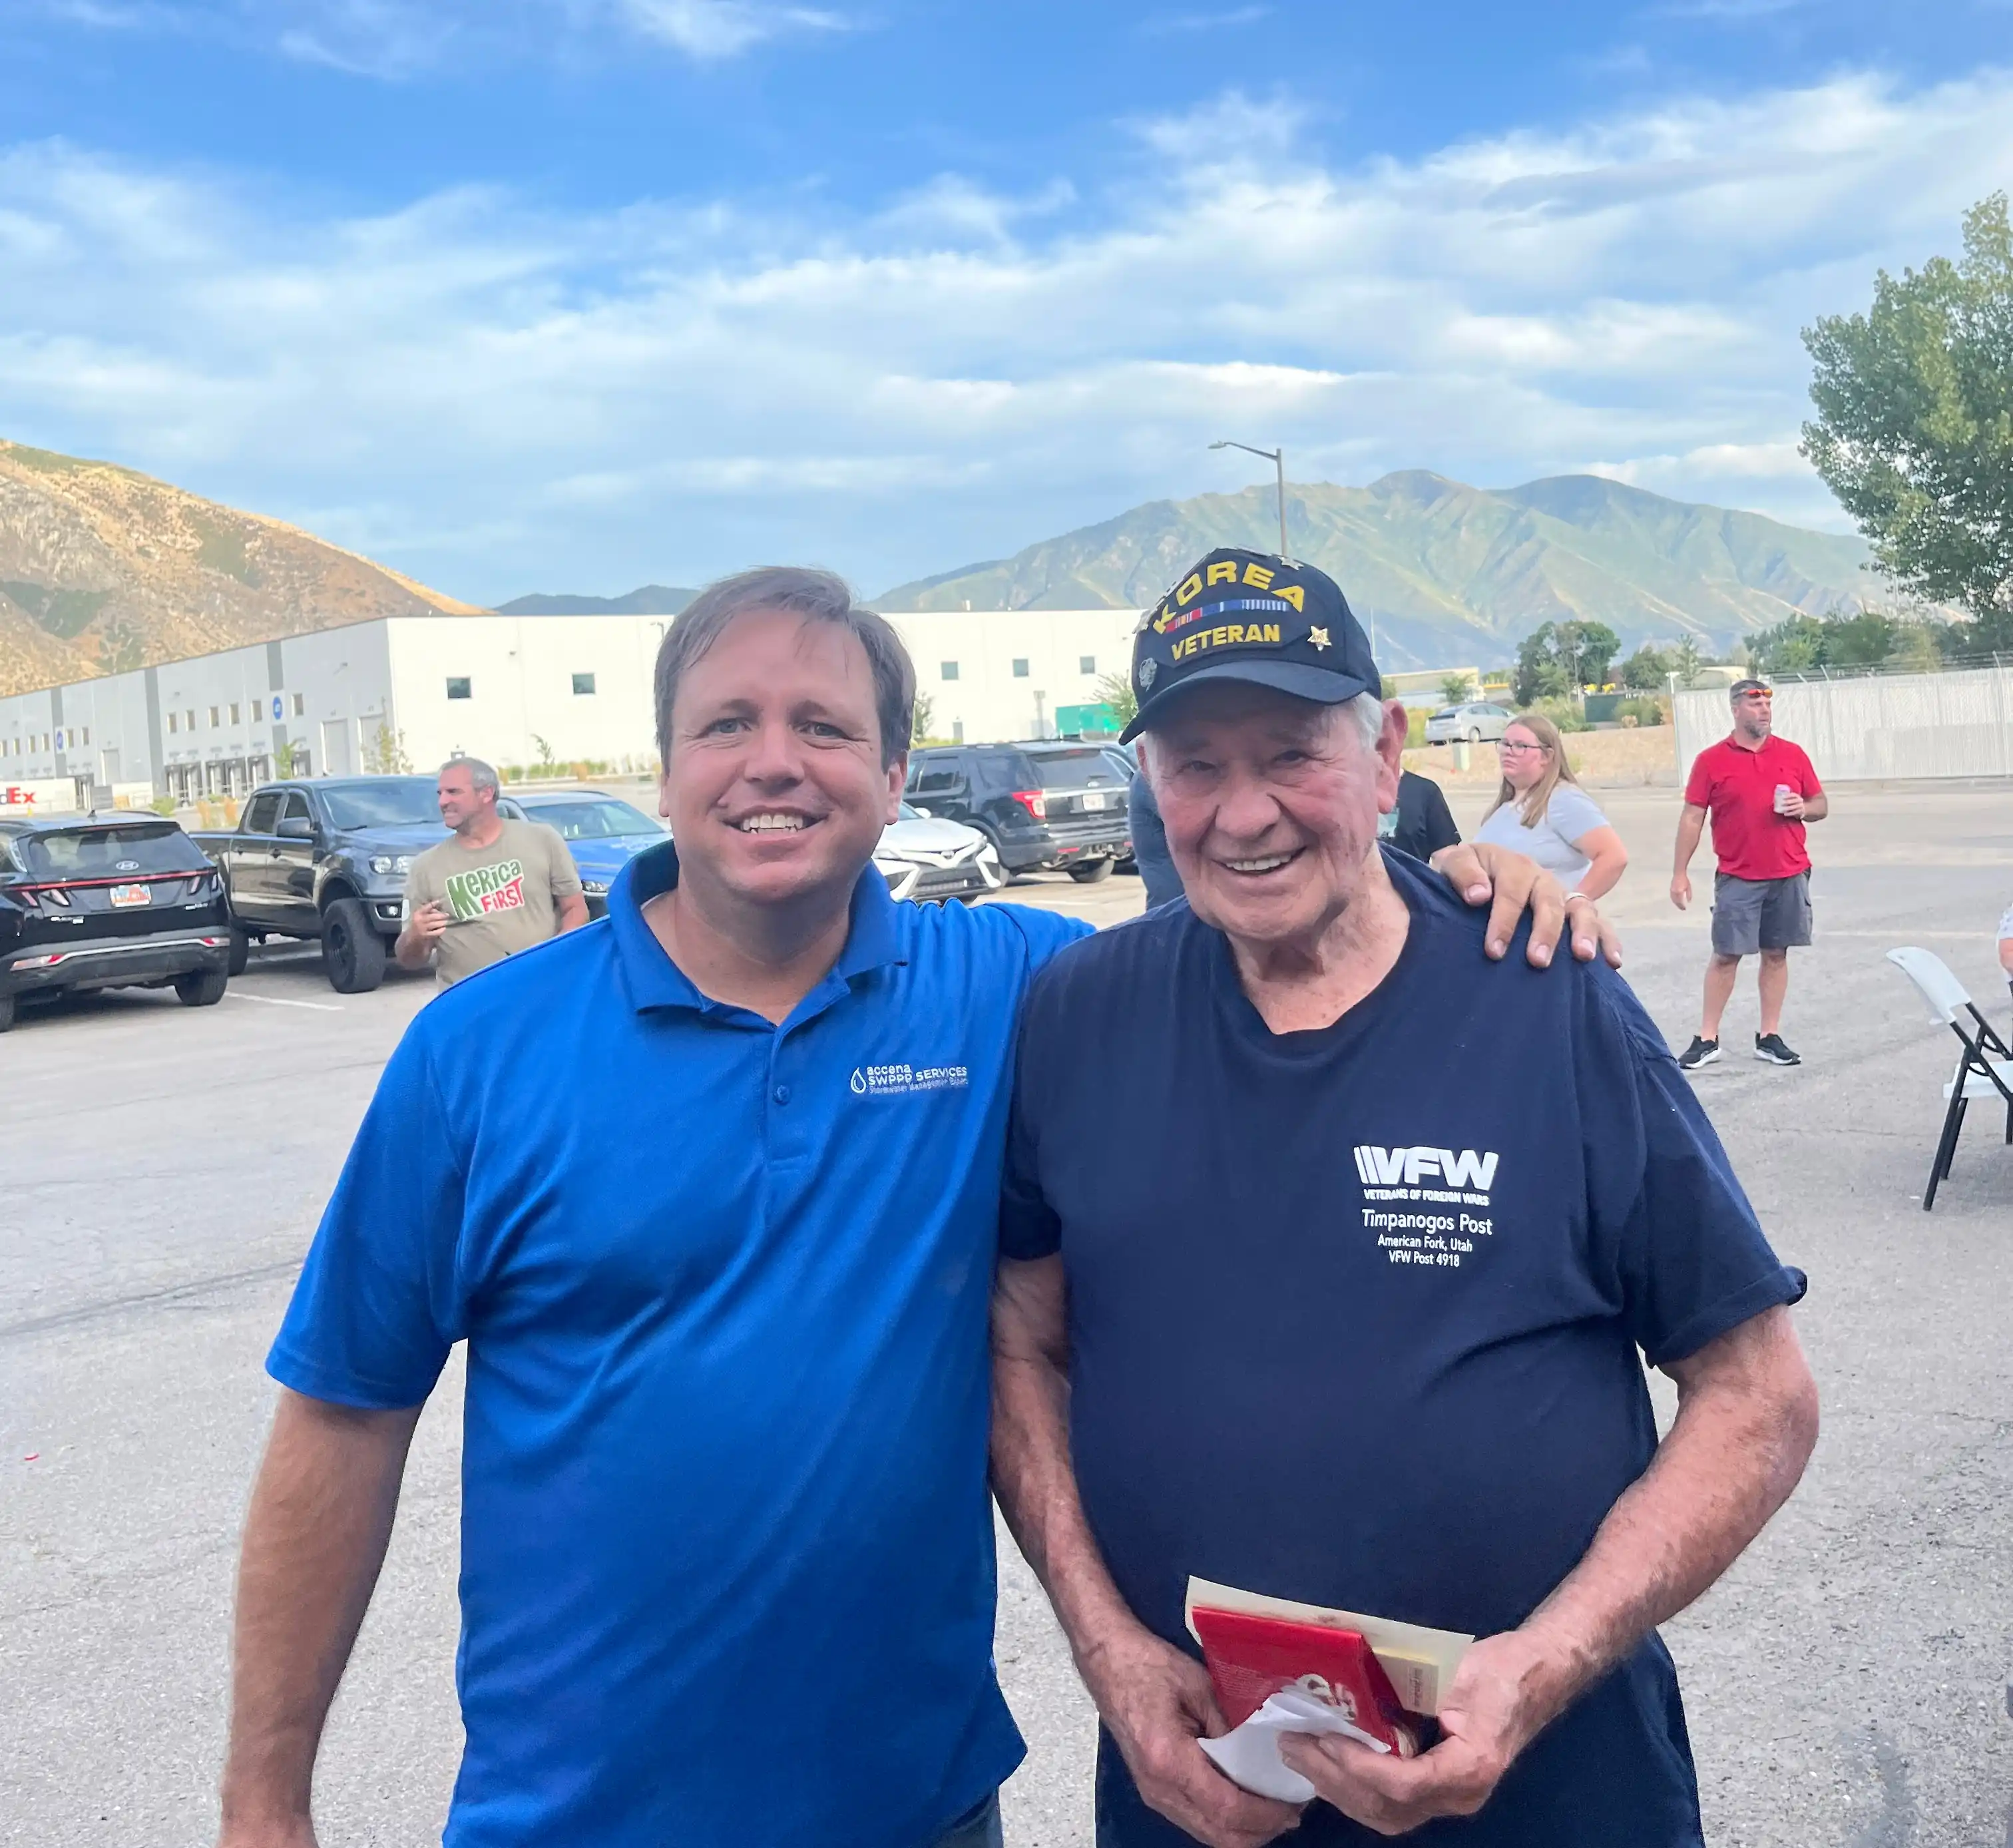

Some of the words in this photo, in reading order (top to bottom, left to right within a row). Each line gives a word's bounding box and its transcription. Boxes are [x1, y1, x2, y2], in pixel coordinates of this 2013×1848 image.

[1152, 561, 1305, 634] KOREA
[1171, 624, 1280, 661] VETERAN
[867, 1064, 911, 1075] accena
[868, 1074, 913, 1086] SWPPP
[915, 1066, 967, 1081] SERVICES
[1353, 1145, 1499, 1191] VFW
[1363, 1188, 1409, 1200] VETERANS
[1409, 1189, 1421, 1200] OF
[1423, 1190, 1461, 1203] FOREIGN
[1462, 1192, 1490, 1206] WARS
[1361, 1208, 1454, 1234] Timpanogos
[1459, 1213, 1493, 1235] Post
[1377, 1234, 1421, 1248] American
[1424, 1236, 1448, 1252] Fork,
[1451, 1238, 1473, 1252] Utah
[1389, 1250, 1411, 1264] VFW
[1413, 1251, 1434, 1265] Post
[1436, 1254, 1460, 1268] 4918
